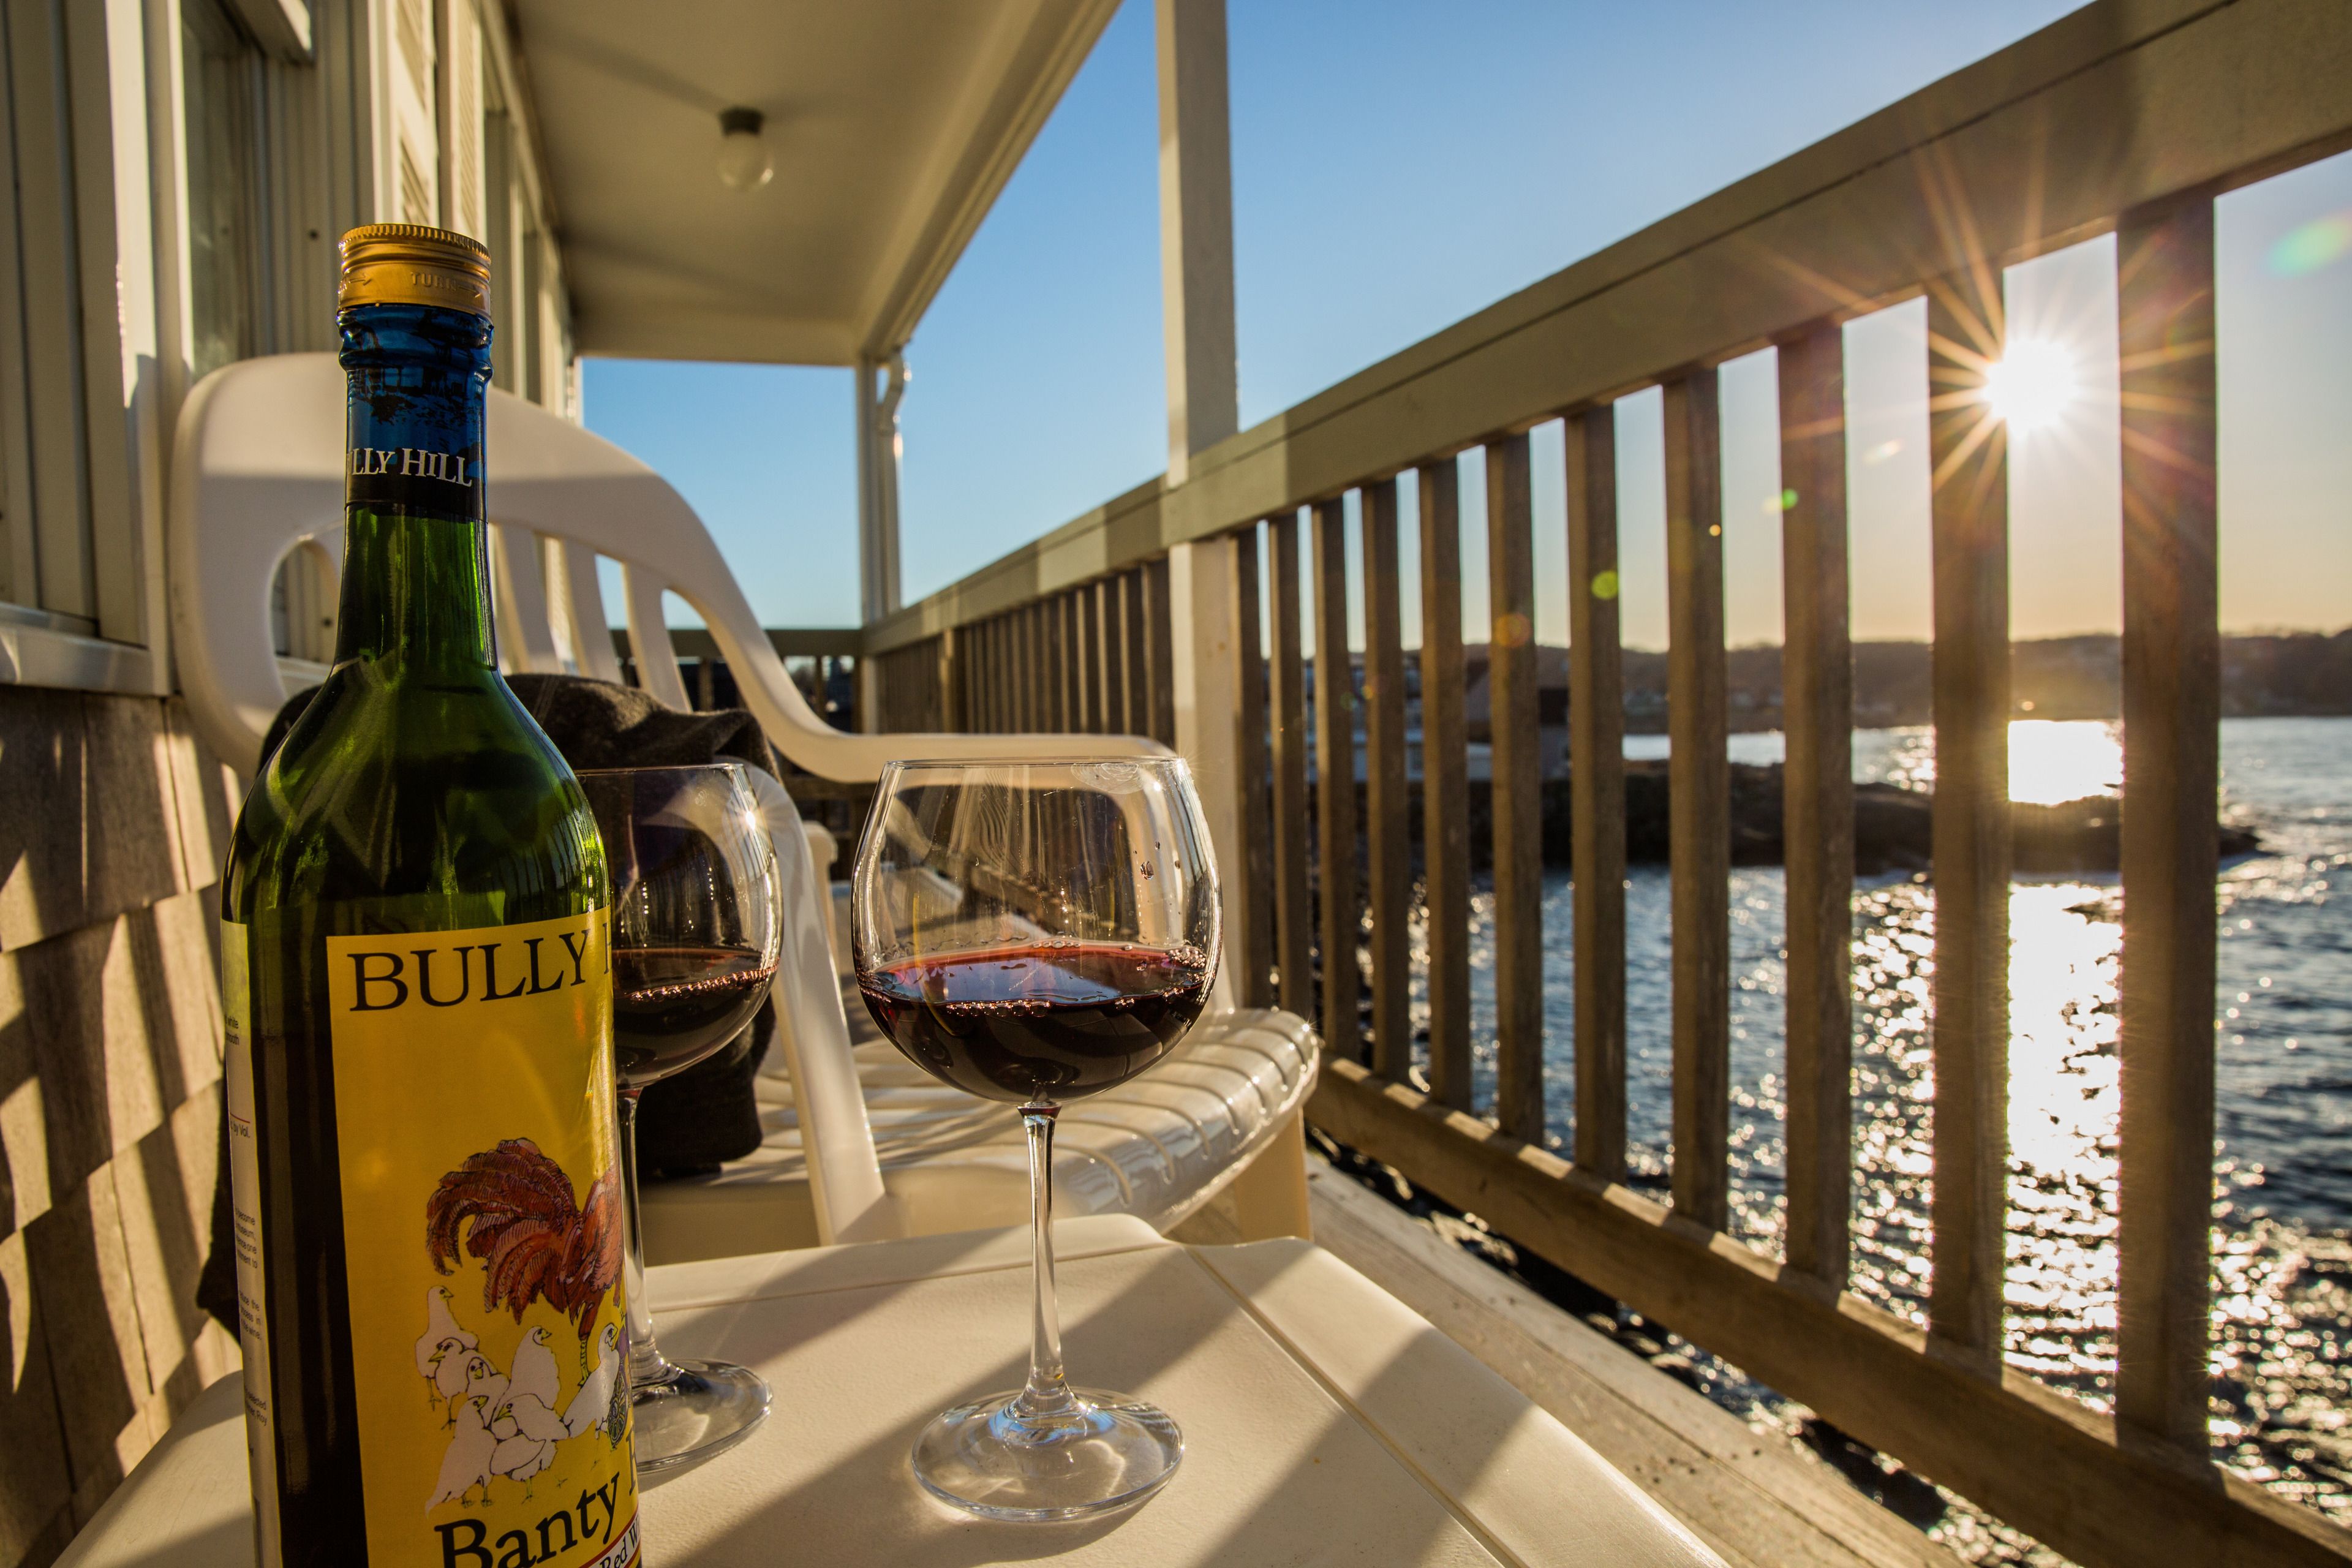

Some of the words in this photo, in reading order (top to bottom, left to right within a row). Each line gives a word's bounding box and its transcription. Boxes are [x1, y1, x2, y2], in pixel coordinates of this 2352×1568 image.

[411, 271, 457, 291] TURN
[400, 448, 472, 487] HILL
[347, 929, 591, 1012] BULLY
[434, 1471, 620, 1568] Banty
[600, 1536, 628, 1568] Red
